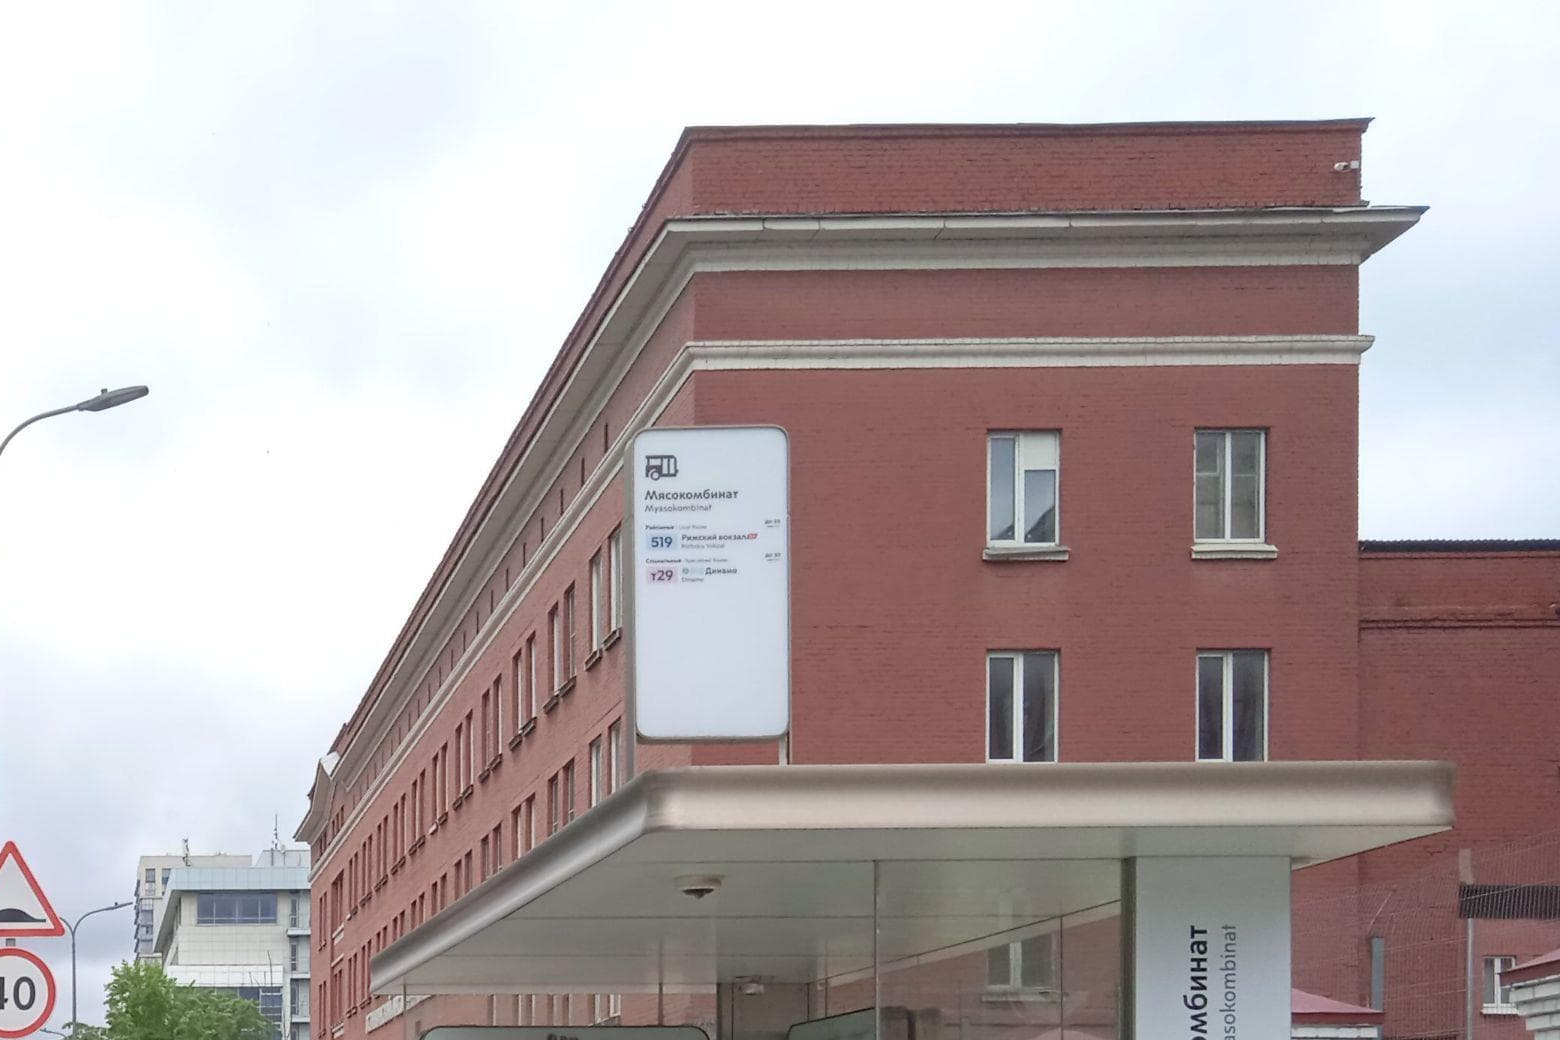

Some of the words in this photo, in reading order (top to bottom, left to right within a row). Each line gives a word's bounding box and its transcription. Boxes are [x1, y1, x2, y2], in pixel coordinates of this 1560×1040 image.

[644, 489, 738, 500] Мясокомбинат
[644, 504, 712, 513] Myasokombinat
[651, 536, 673, 548] 519
[651, 569, 674, 581] т29
